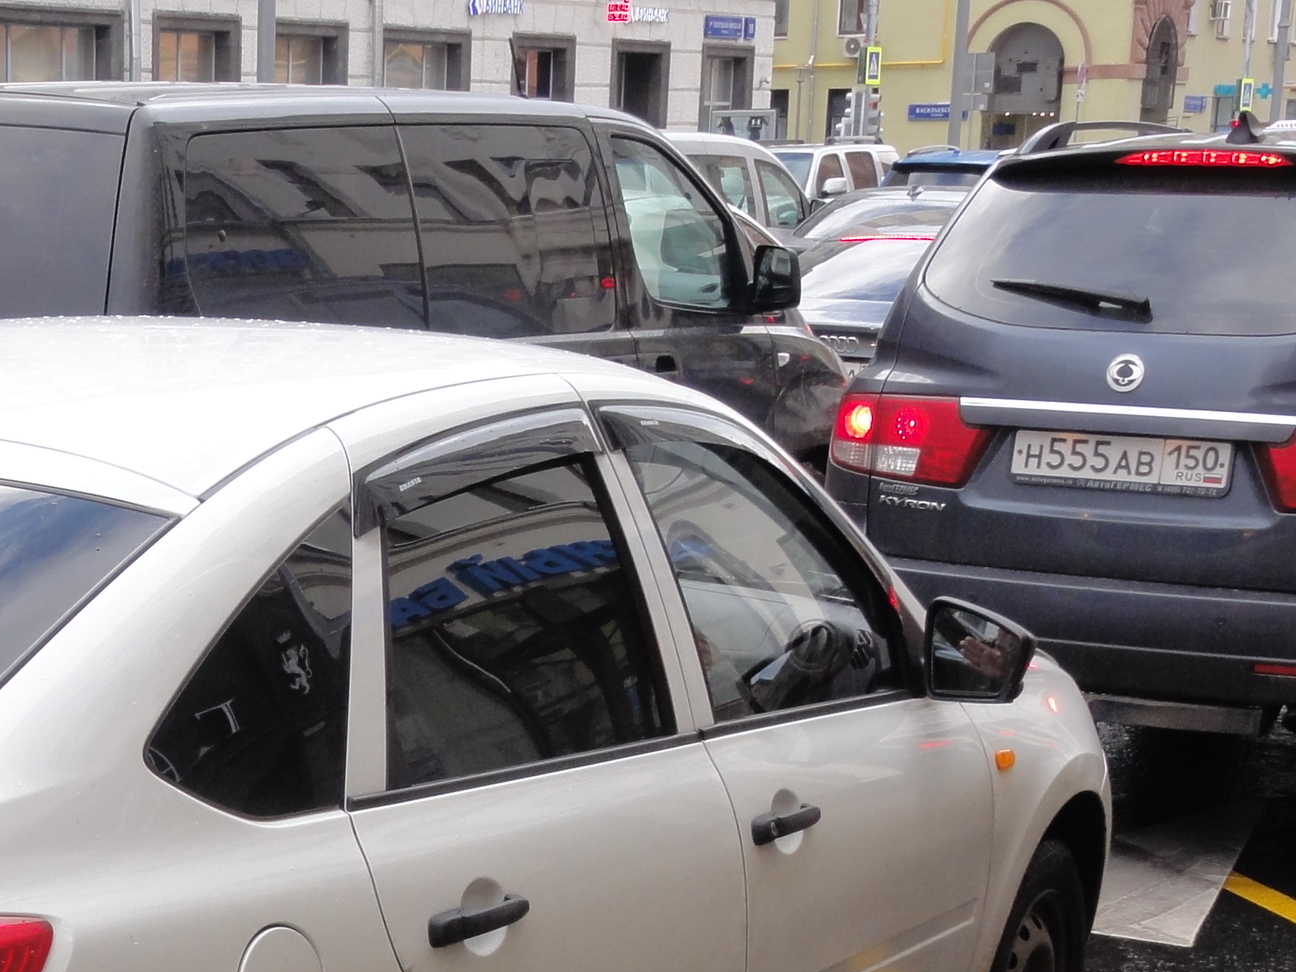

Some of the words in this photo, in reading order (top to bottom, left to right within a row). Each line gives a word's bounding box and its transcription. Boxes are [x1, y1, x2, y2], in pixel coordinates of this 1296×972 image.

[1024, 437, 1155, 477] Н555АВ
[1167, 444, 1220, 473] 150
[1175, 471, 1203, 483] RUS
[878, 494, 947, 512] KYRON
